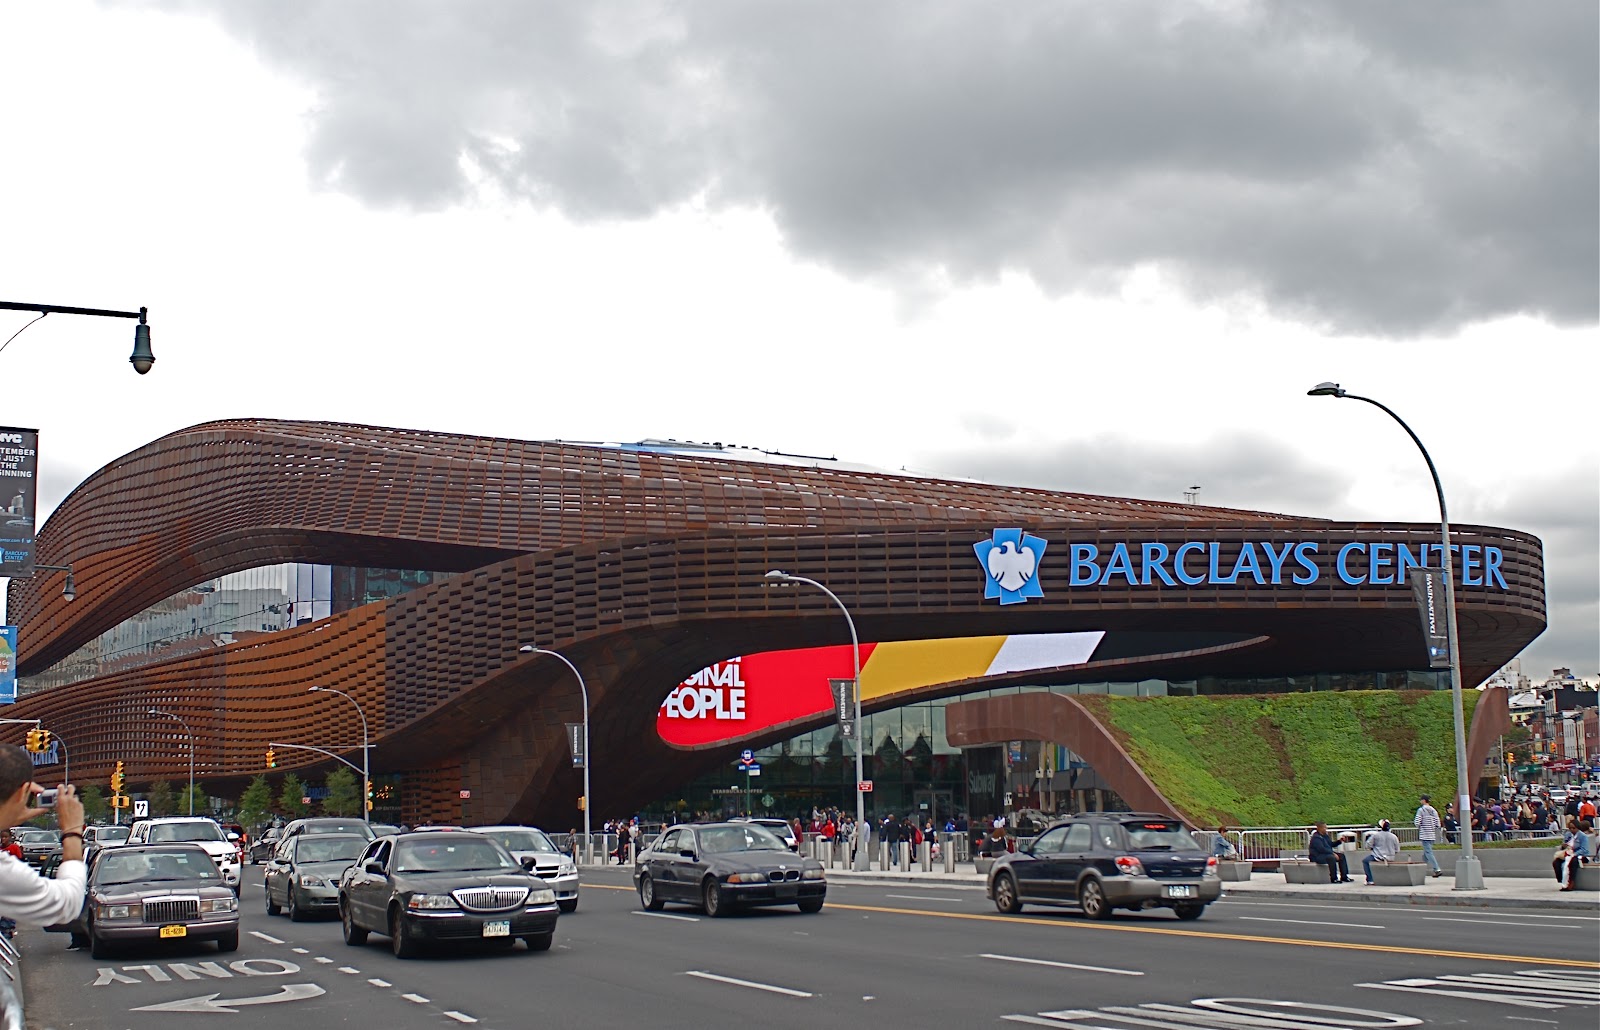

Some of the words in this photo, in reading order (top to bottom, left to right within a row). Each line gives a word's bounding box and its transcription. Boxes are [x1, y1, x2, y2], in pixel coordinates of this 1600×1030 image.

[1069, 542, 1319, 586] BARCLAYS
[1336, 542, 1509, 589] CENTER
[658, 687, 745, 719] EOPLE
[969, 769, 996, 798] Subway
[93, 959, 300, 986] ONLY
